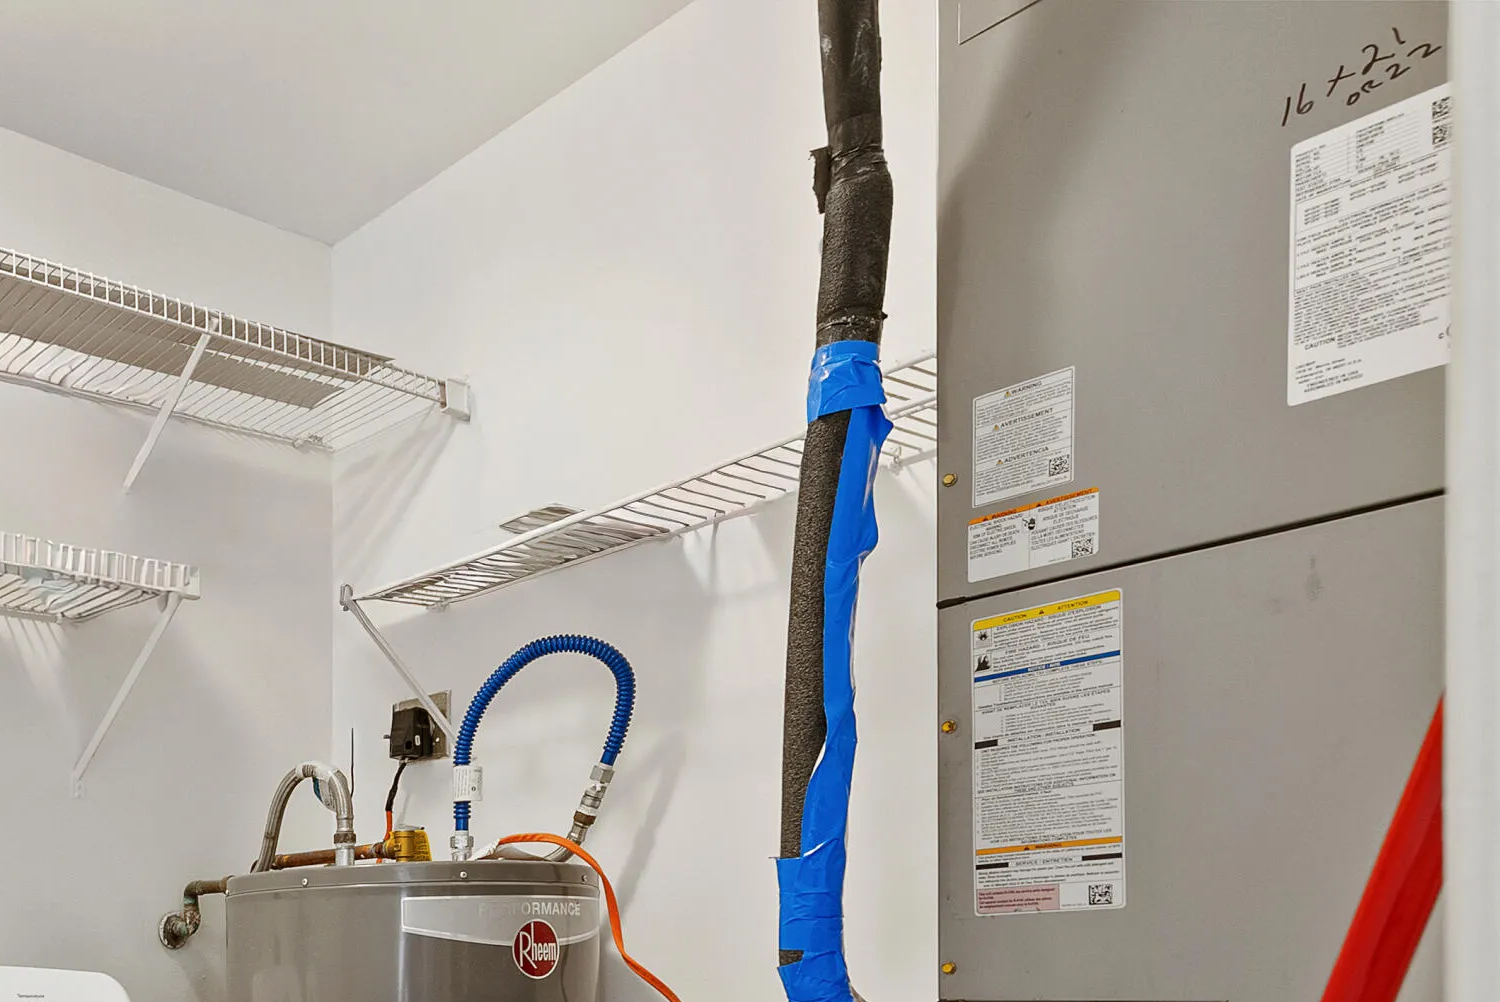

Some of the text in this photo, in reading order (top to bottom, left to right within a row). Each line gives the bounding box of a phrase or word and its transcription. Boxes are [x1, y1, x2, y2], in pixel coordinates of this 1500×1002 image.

[1281, 82, 1314, 127] 16
[1304, 336, 1336, 351] CAUTION
[1011, 382, 1043, 395] WARNING
[1000, 407, 1054, 428] AVERTISSEMENT
[1003, 446, 1050, 463] ADVERTENCIA
[479, 901, 581, 916] PORMANCE
[519, 922, 557, 969] Rheem
